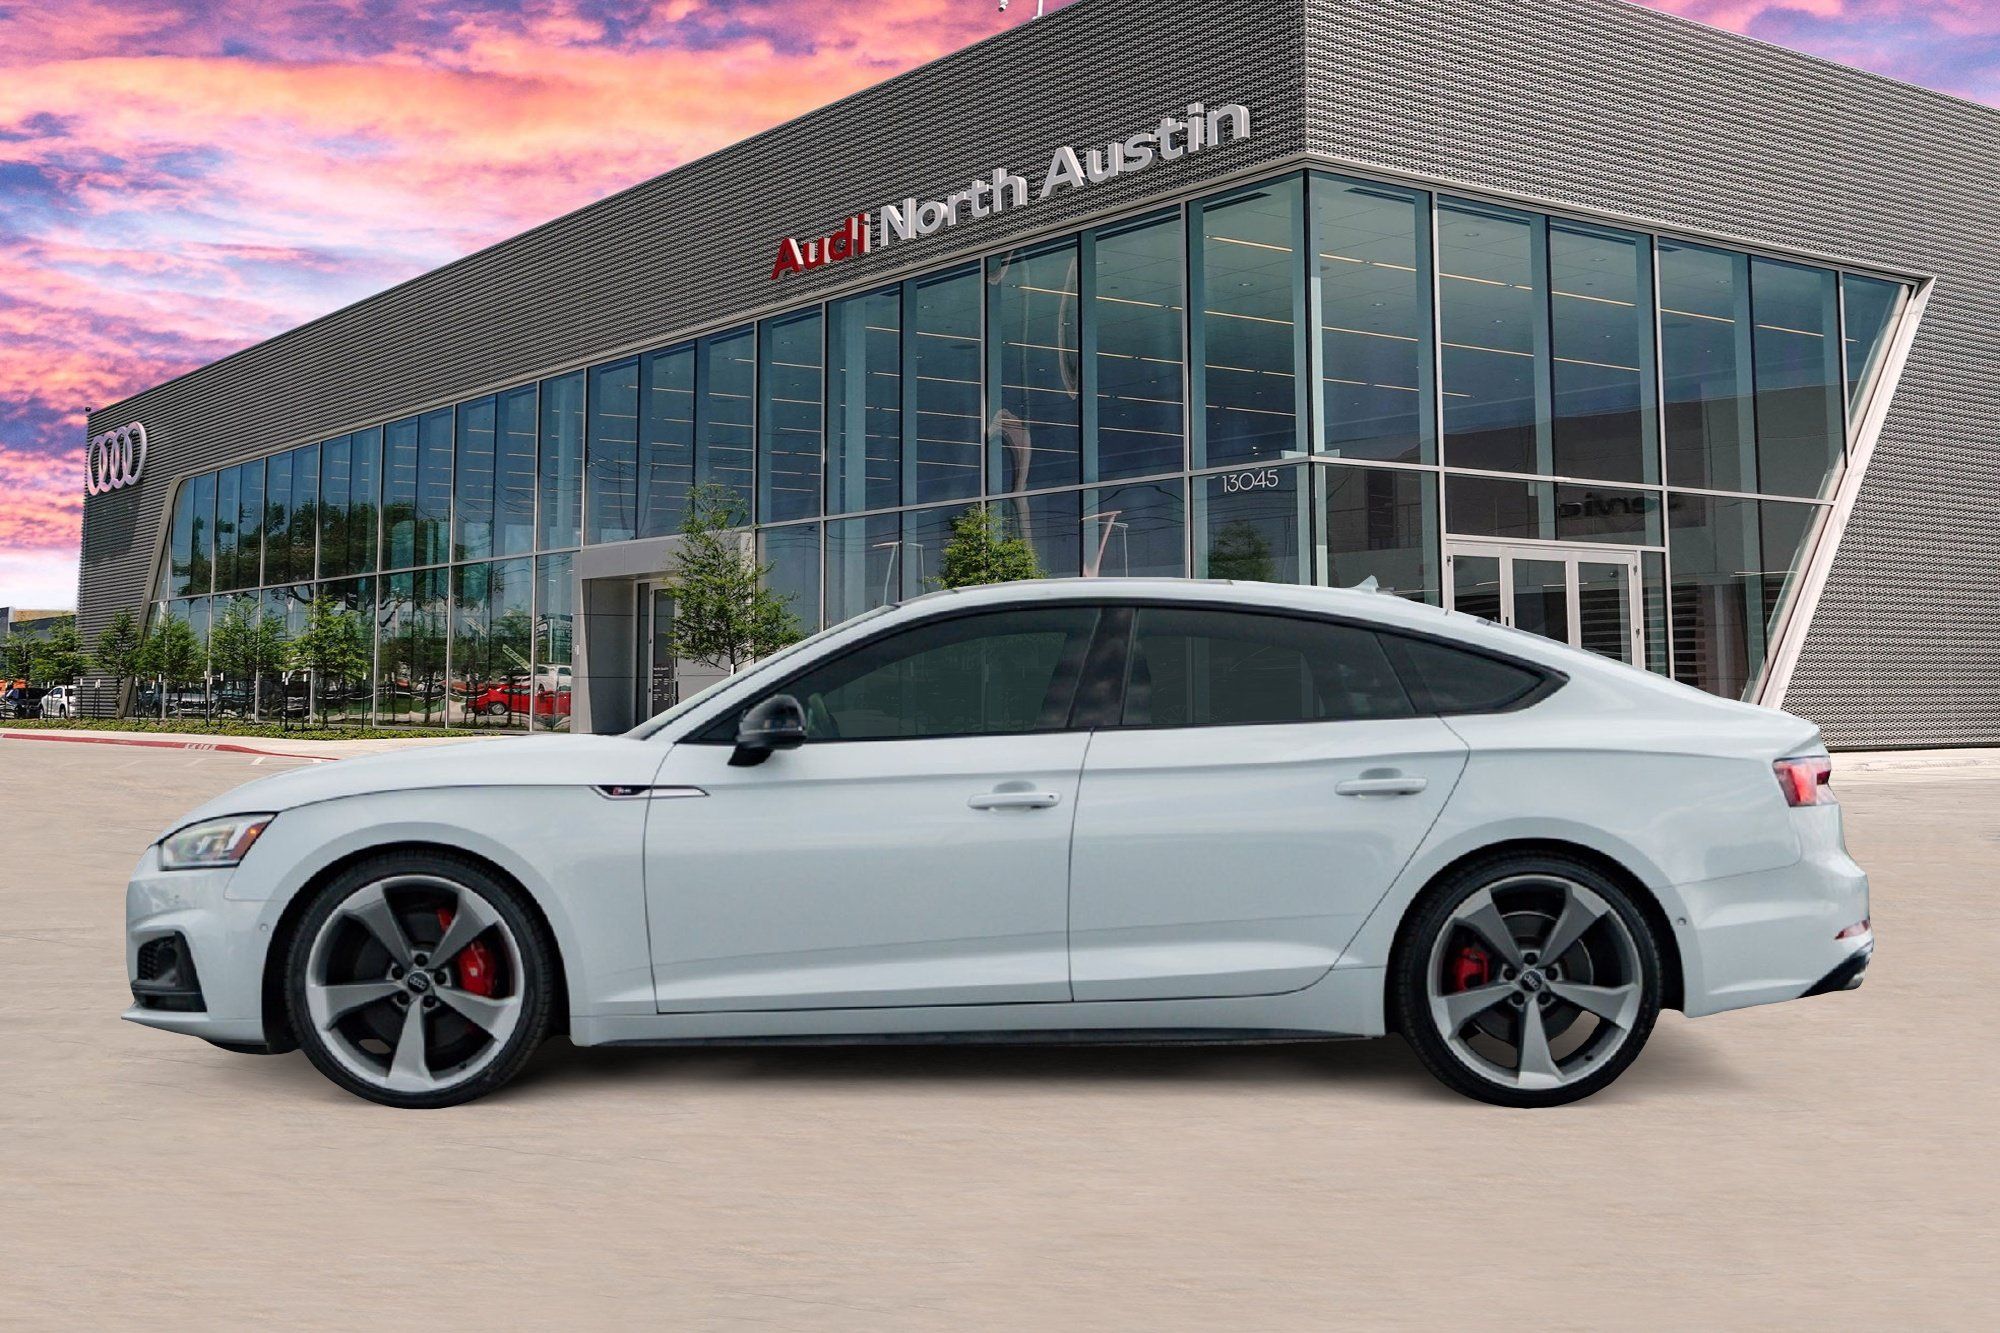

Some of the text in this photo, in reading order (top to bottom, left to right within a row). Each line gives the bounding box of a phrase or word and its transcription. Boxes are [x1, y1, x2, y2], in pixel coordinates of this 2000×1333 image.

[770, 102, 1250, 280] Audi North Austin
[1222, 469, 1279, 493] 13045
